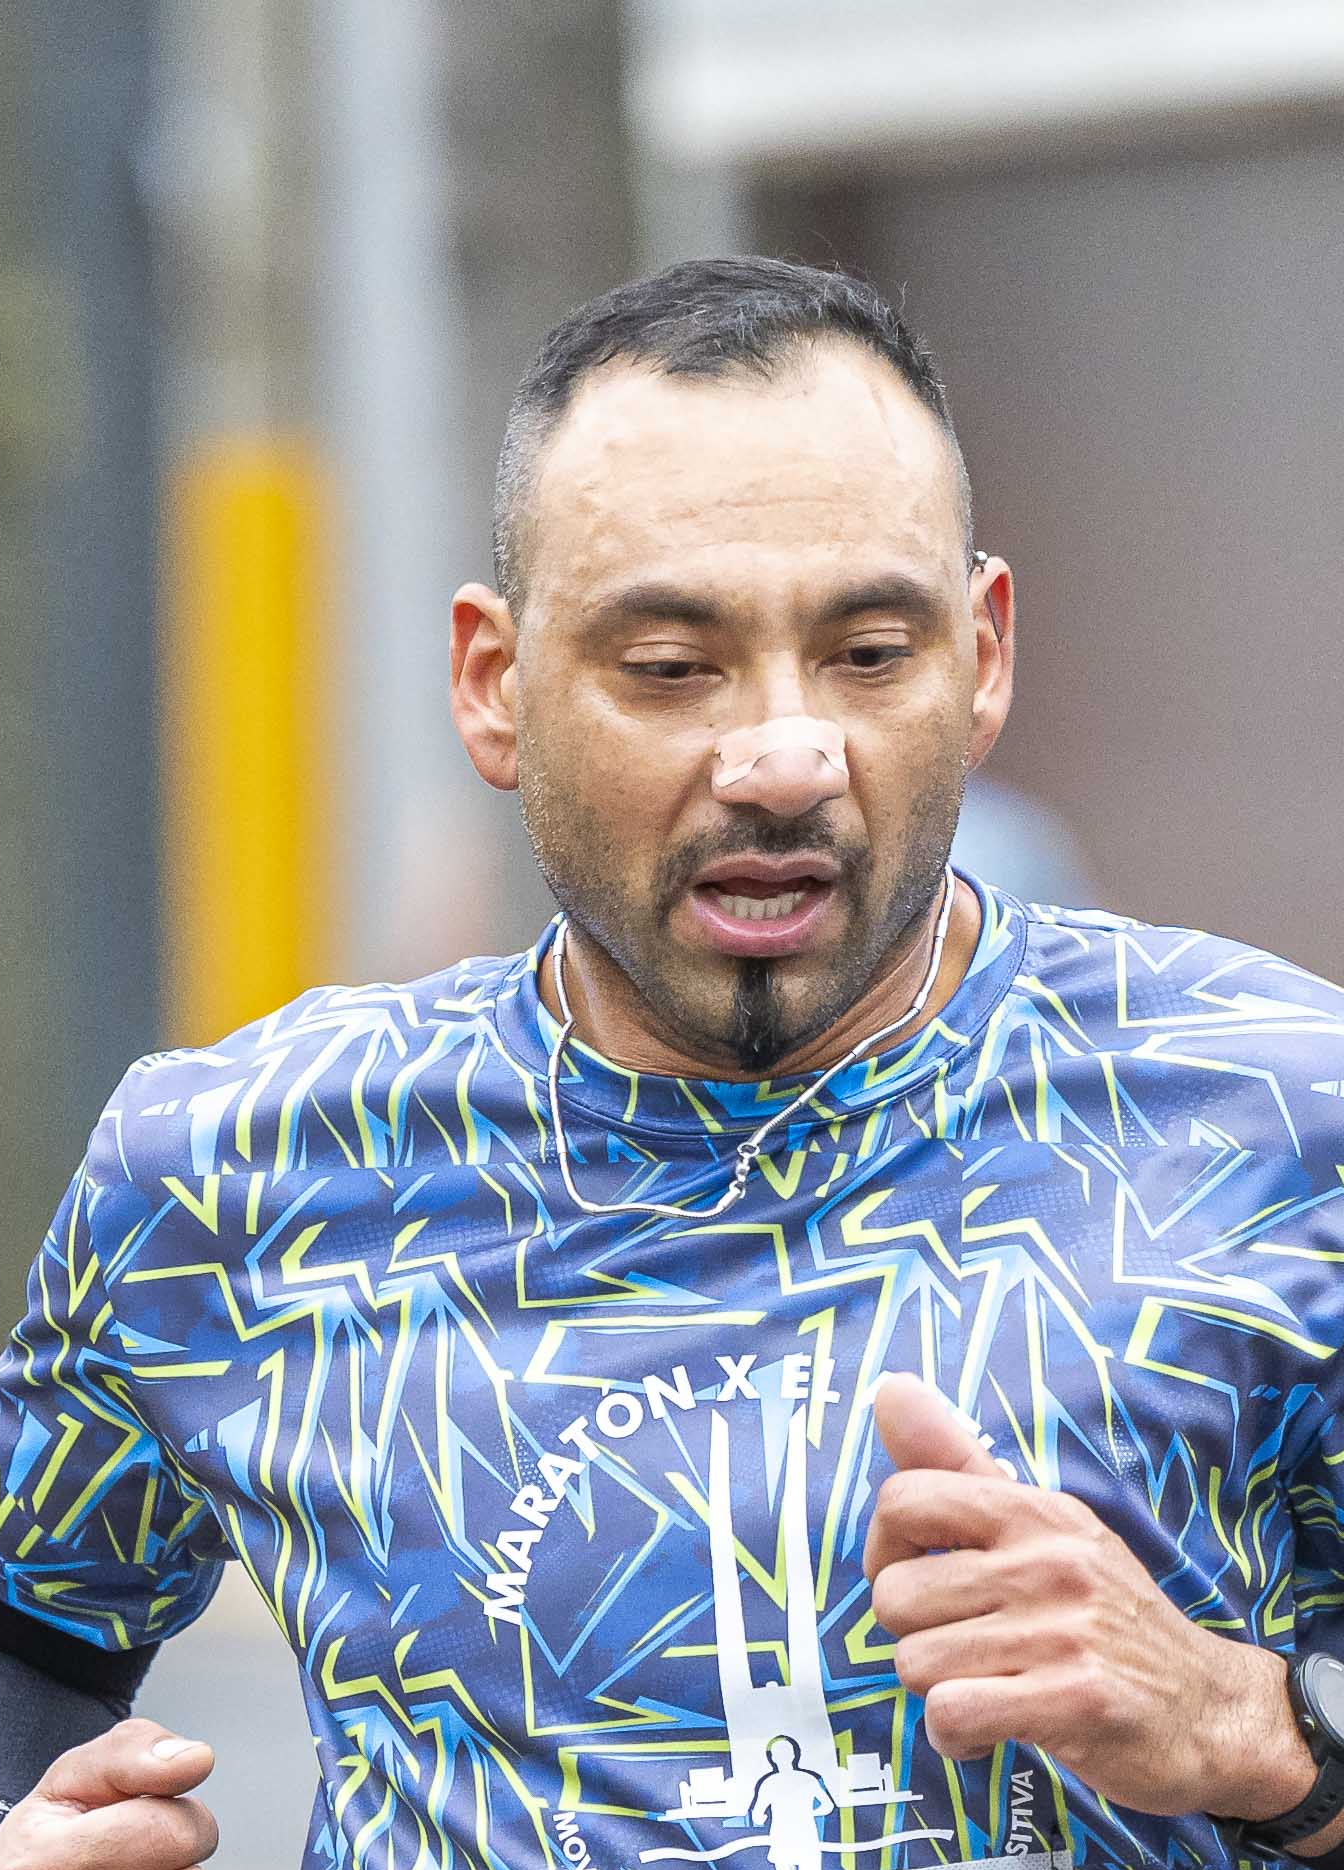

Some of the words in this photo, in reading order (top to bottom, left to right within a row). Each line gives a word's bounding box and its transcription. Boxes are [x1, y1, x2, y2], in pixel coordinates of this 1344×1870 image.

[483, 1364, 696, 1626] MARATÓN
[715, 1354, 758, 1402] X
[781, 1354, 841, 1403] EL
[1005, 1769, 1034, 1859] SITIVA
